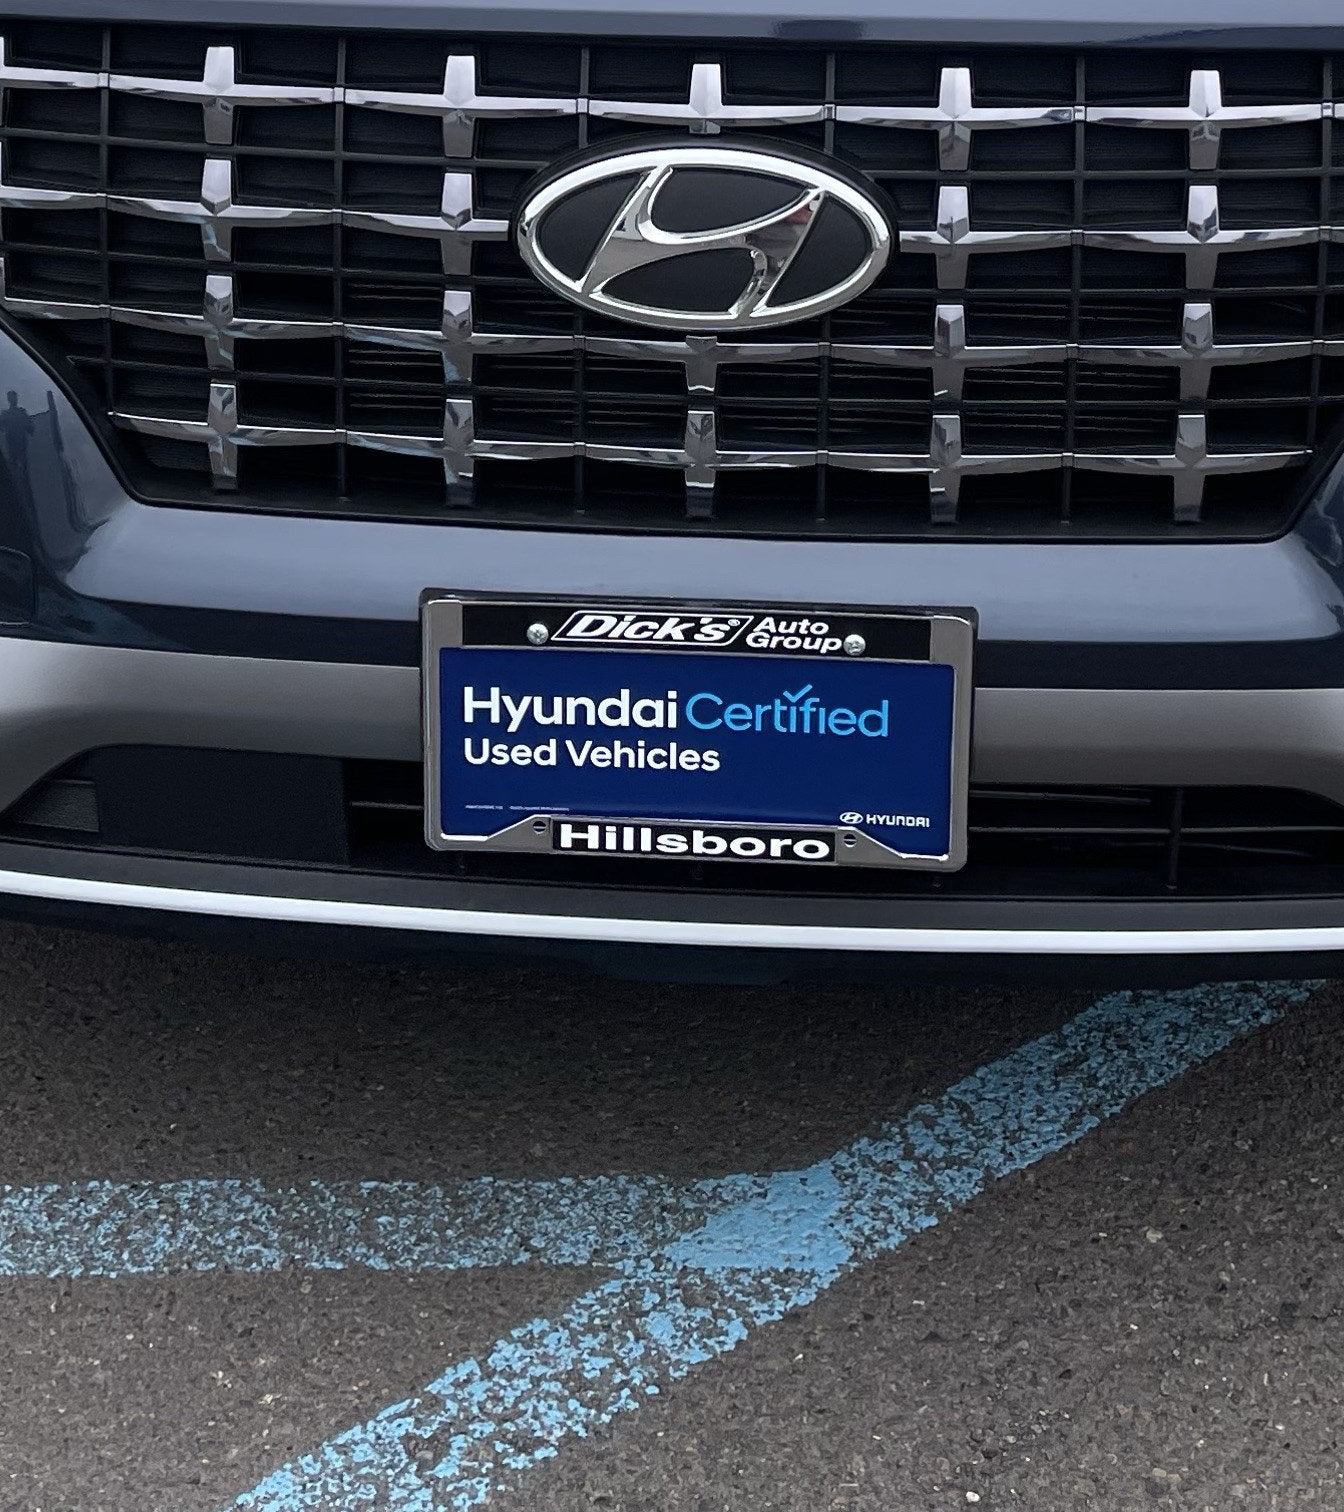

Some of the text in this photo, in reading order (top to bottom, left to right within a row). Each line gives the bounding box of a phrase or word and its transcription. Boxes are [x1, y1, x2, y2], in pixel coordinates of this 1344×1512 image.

[753, 616, 830, 635] Auto
[745, 630, 842, 654] Group
[463, 686, 890, 738] Hyundai Certified
[463, 737, 721, 772] Used Vehicles
[865, 813, 931, 828] HYUNDAI
[559, 823, 831, 860] Hillsboro
